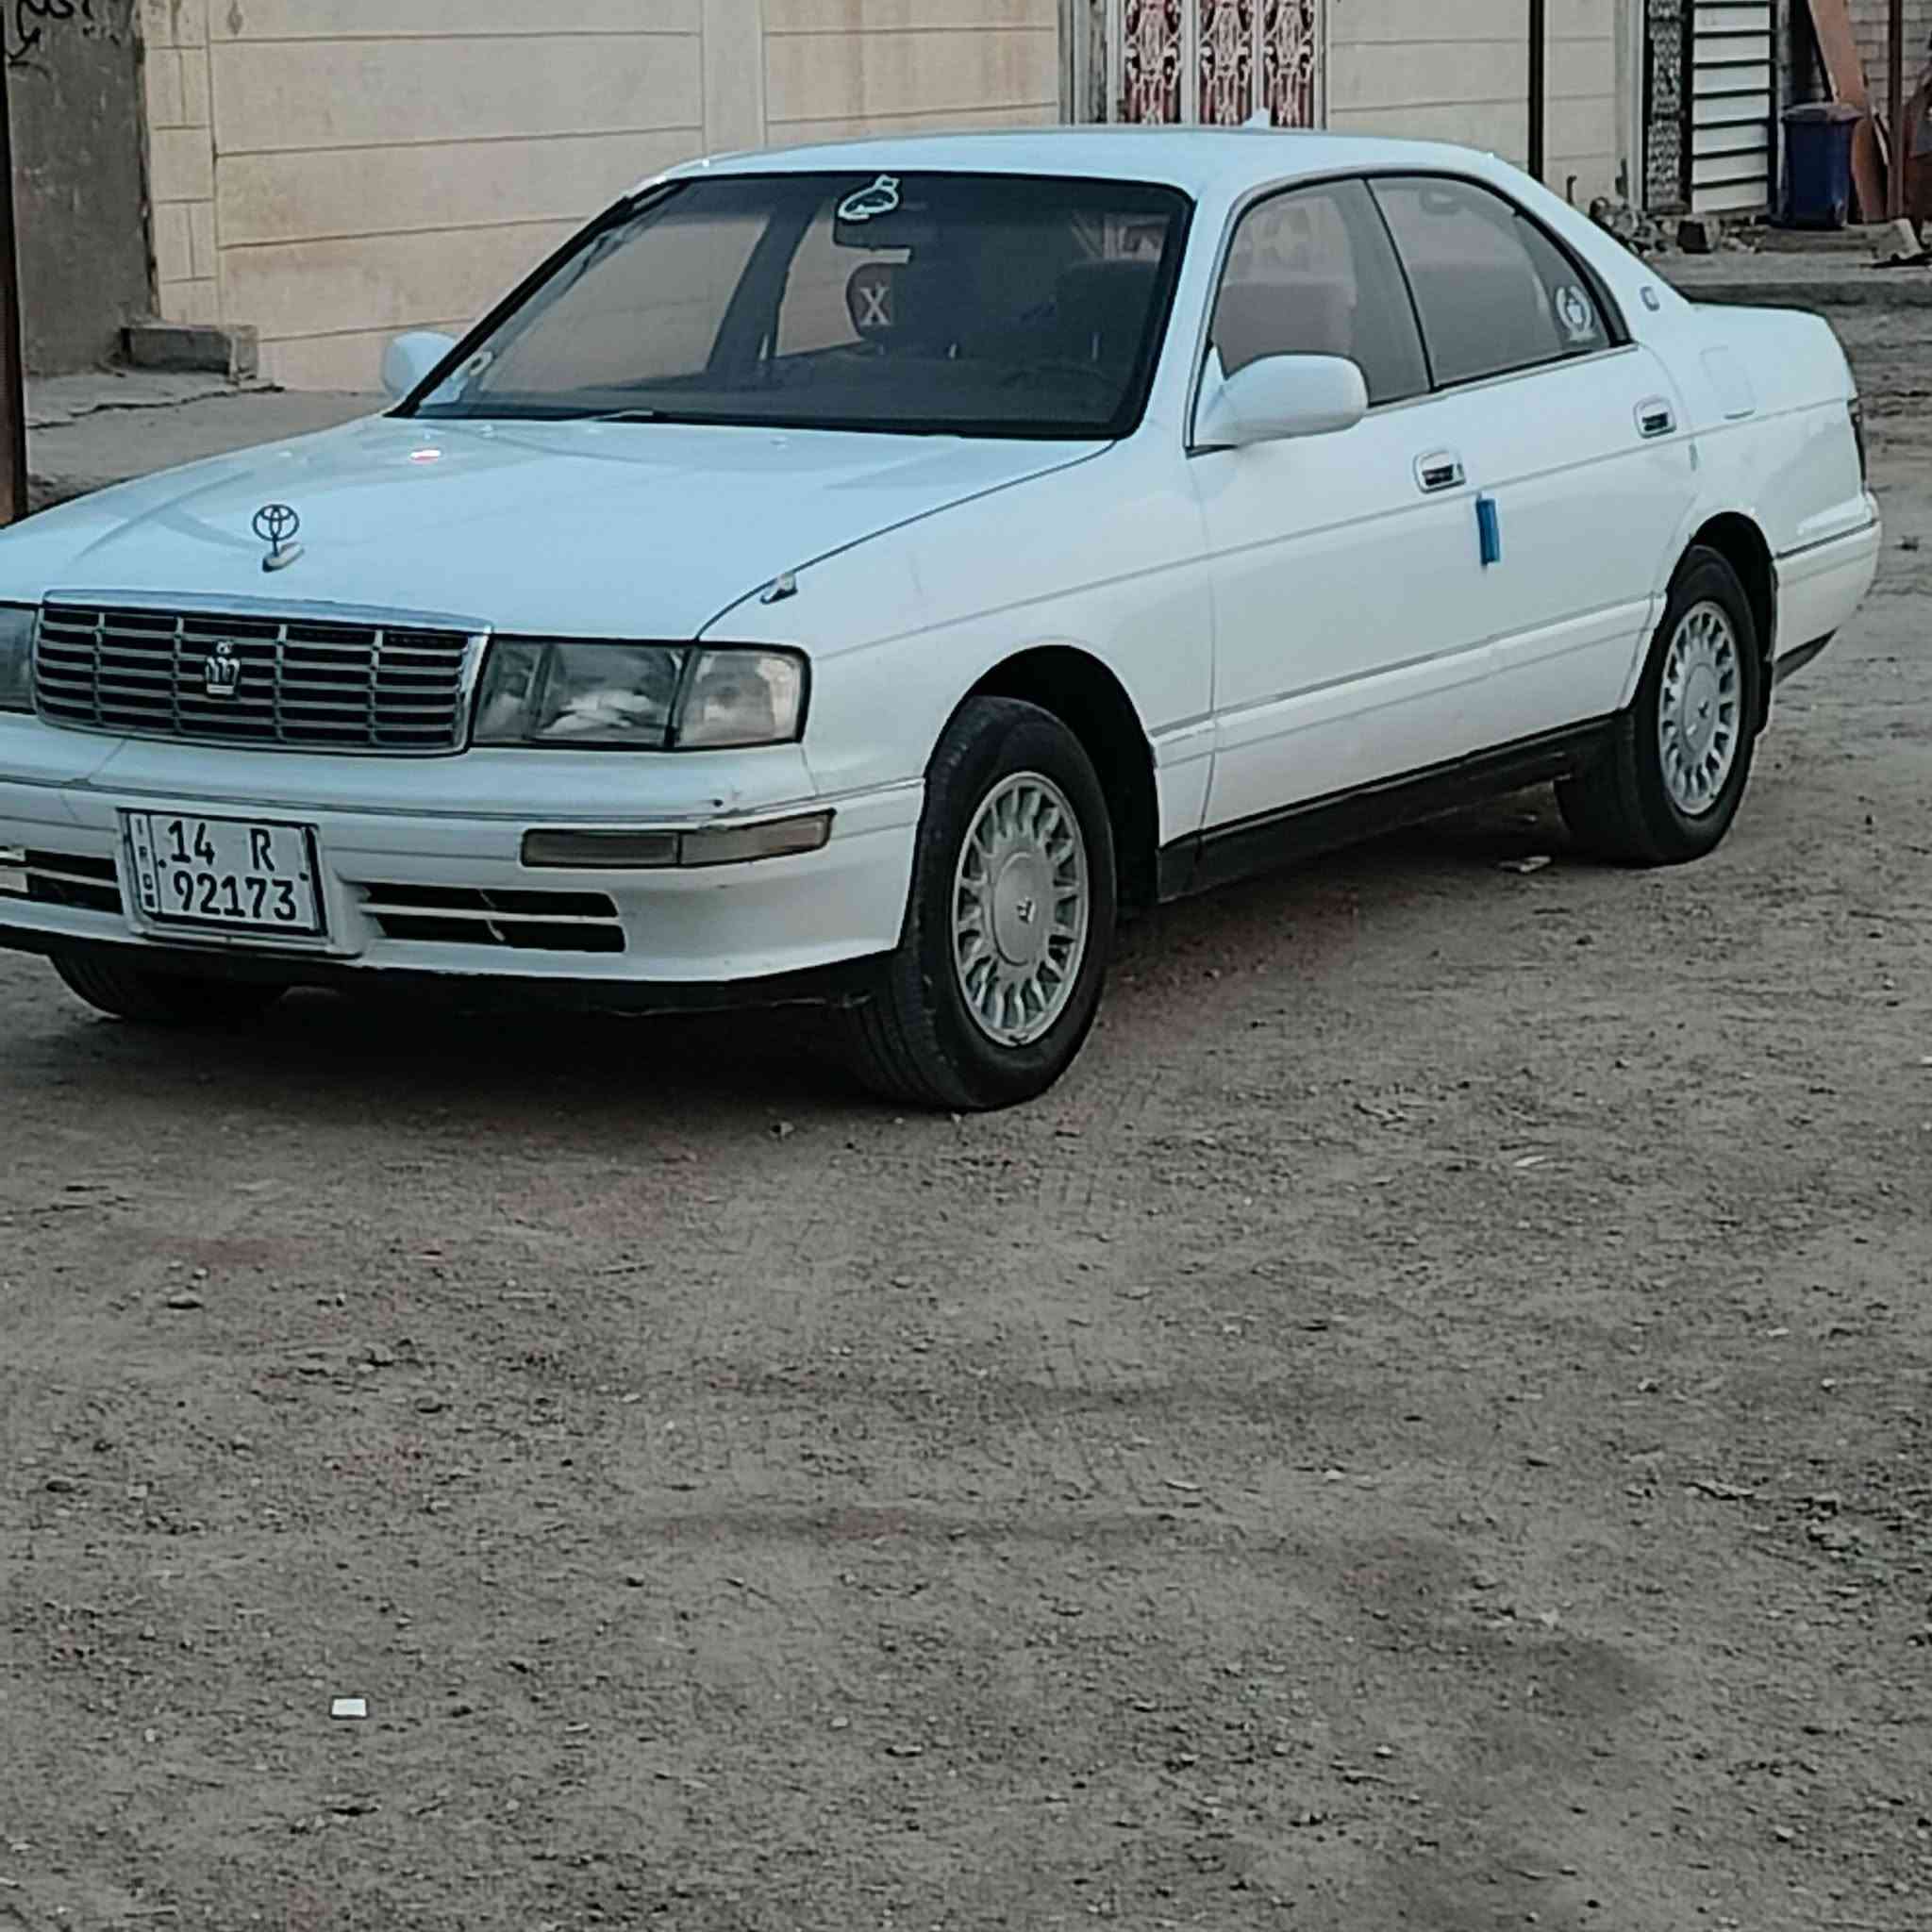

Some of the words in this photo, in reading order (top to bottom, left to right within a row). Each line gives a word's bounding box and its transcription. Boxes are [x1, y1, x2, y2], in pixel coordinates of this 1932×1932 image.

[168, 820, 216, 866] 14
[249, 828, 275, 873] R
[173, 870, 297, 922] 92173
